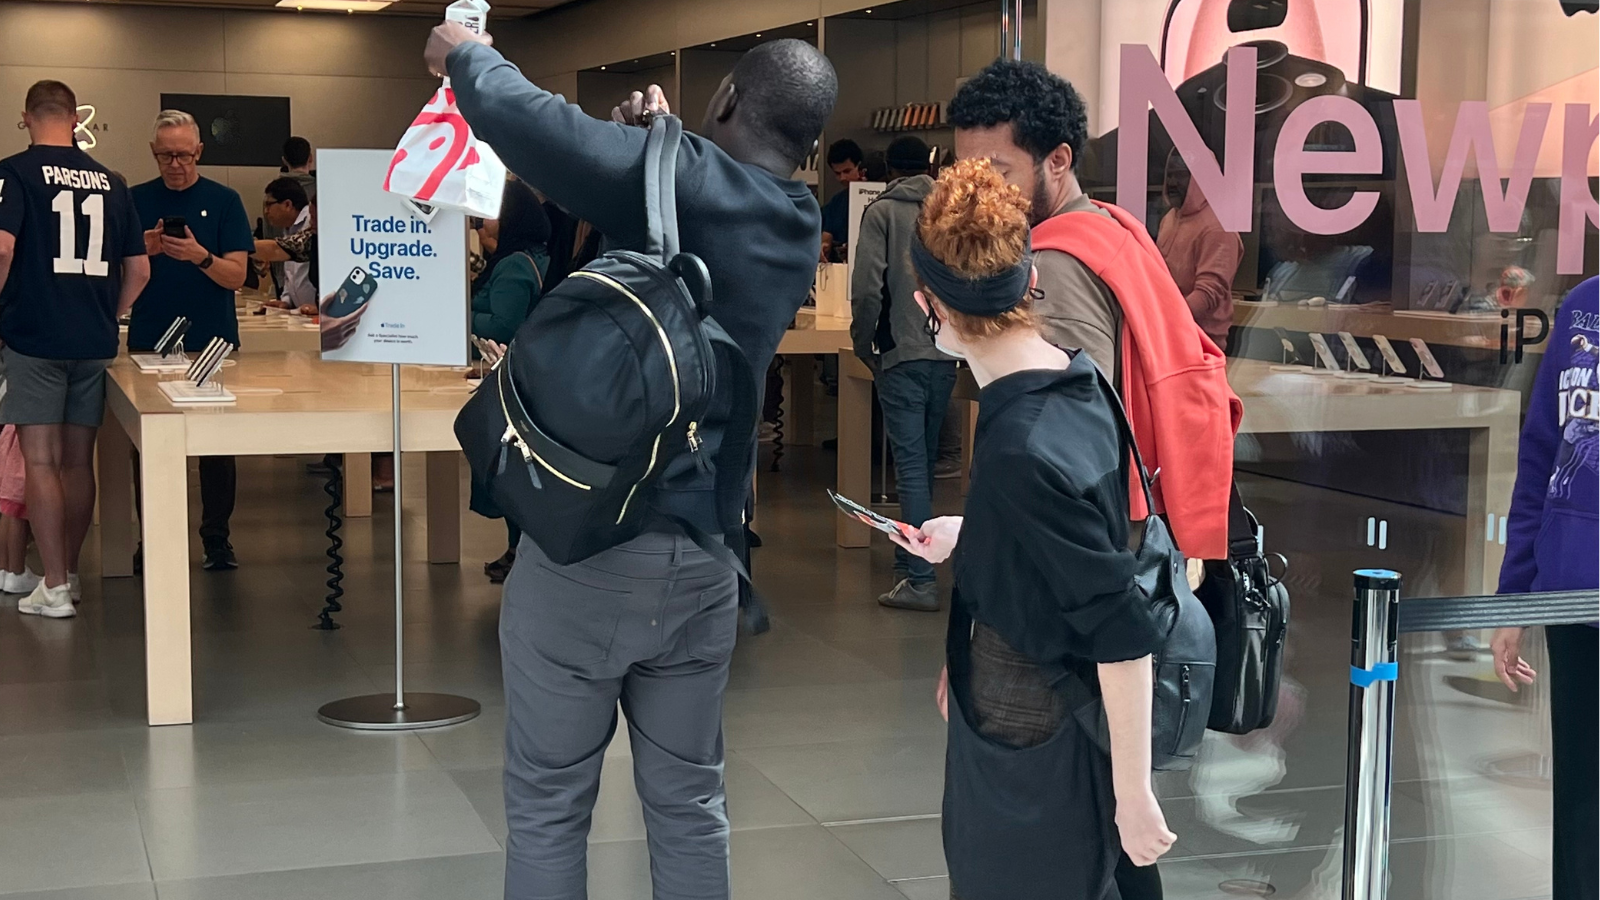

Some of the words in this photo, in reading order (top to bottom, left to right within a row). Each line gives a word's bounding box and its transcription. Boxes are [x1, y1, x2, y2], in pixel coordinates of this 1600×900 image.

[42, 166, 111, 190] PARSONS
[52, 190, 109, 277] 11
[352, 215, 406, 233] Trade
[410, 215, 432, 233] in.
[350, 238, 437, 260] Upgrade.
[369, 261, 420, 280] Save.
